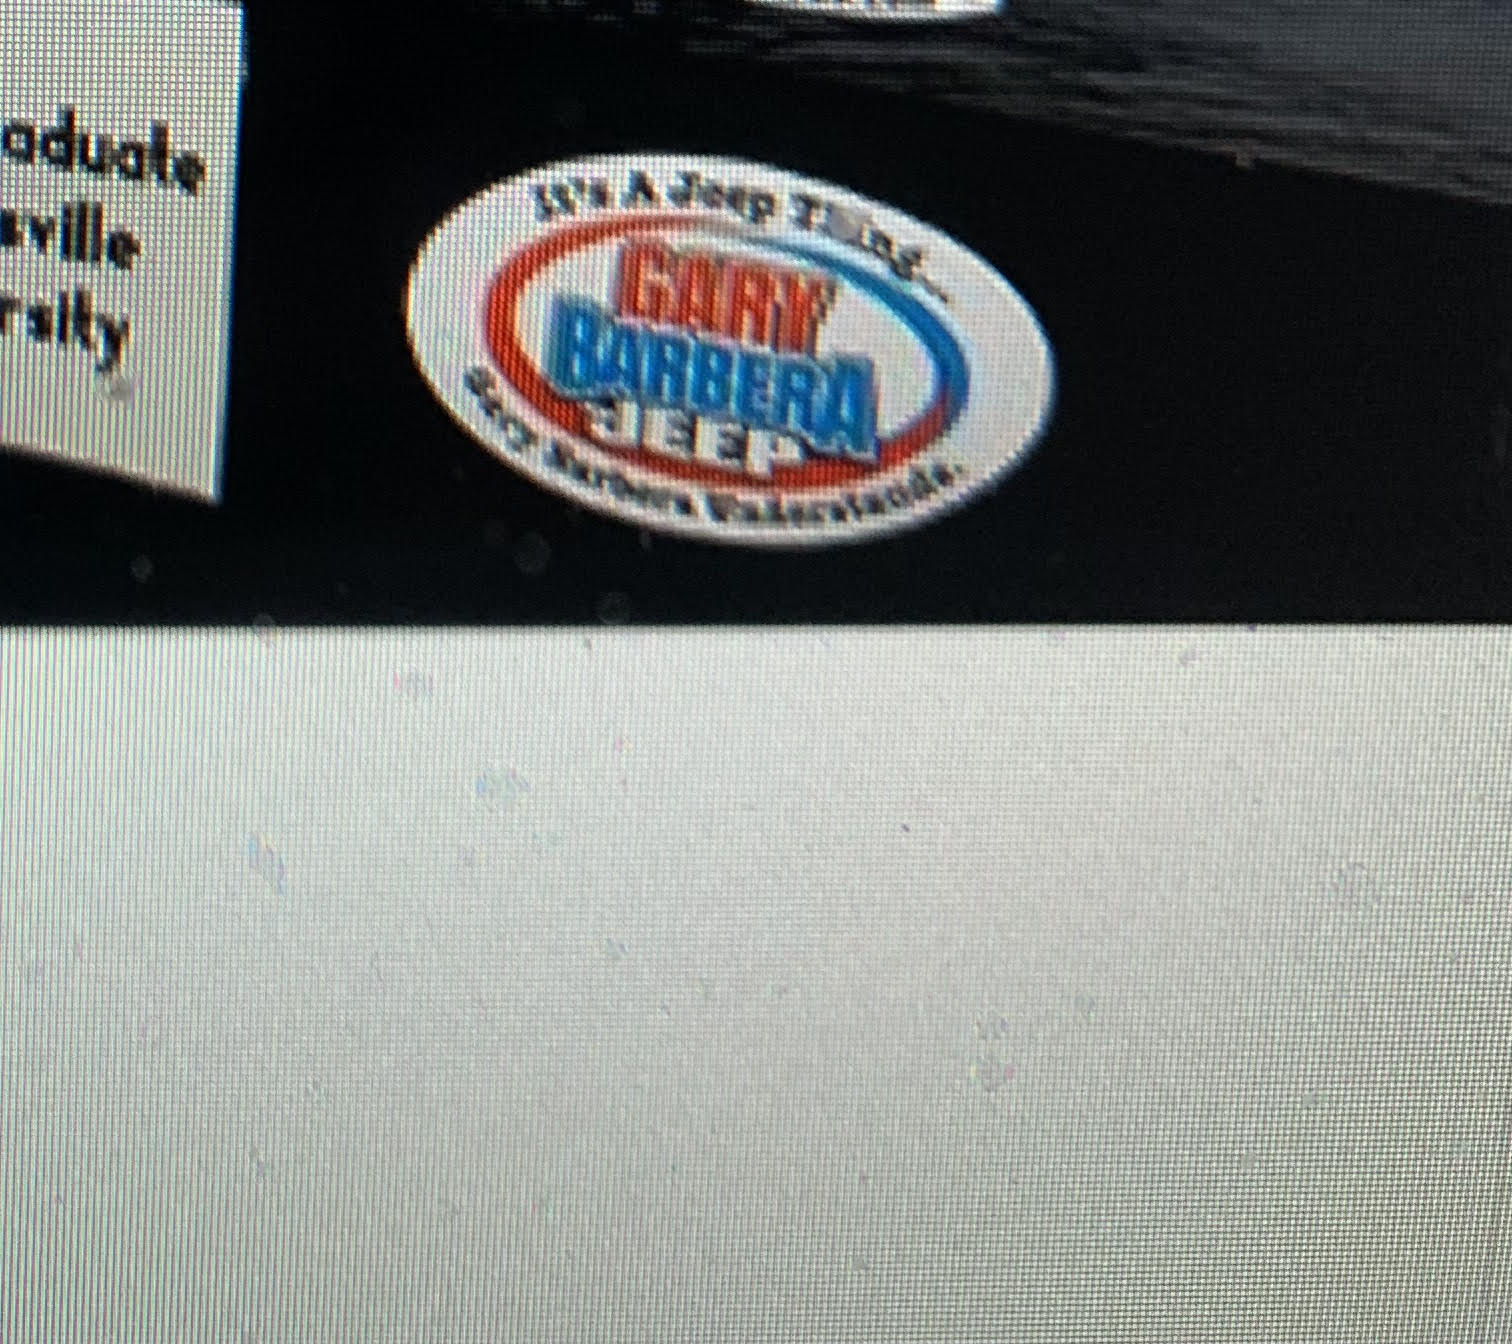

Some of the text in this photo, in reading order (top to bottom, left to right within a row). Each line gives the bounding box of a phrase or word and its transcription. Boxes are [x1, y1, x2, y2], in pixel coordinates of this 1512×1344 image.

[623, 171, 659, 205] A
[669, 170, 778, 225] Jeep
[614, 234, 842, 354] GARY
[546, 294, 883, 468] BARBERA
[586, 400, 803, 479] JEEP
